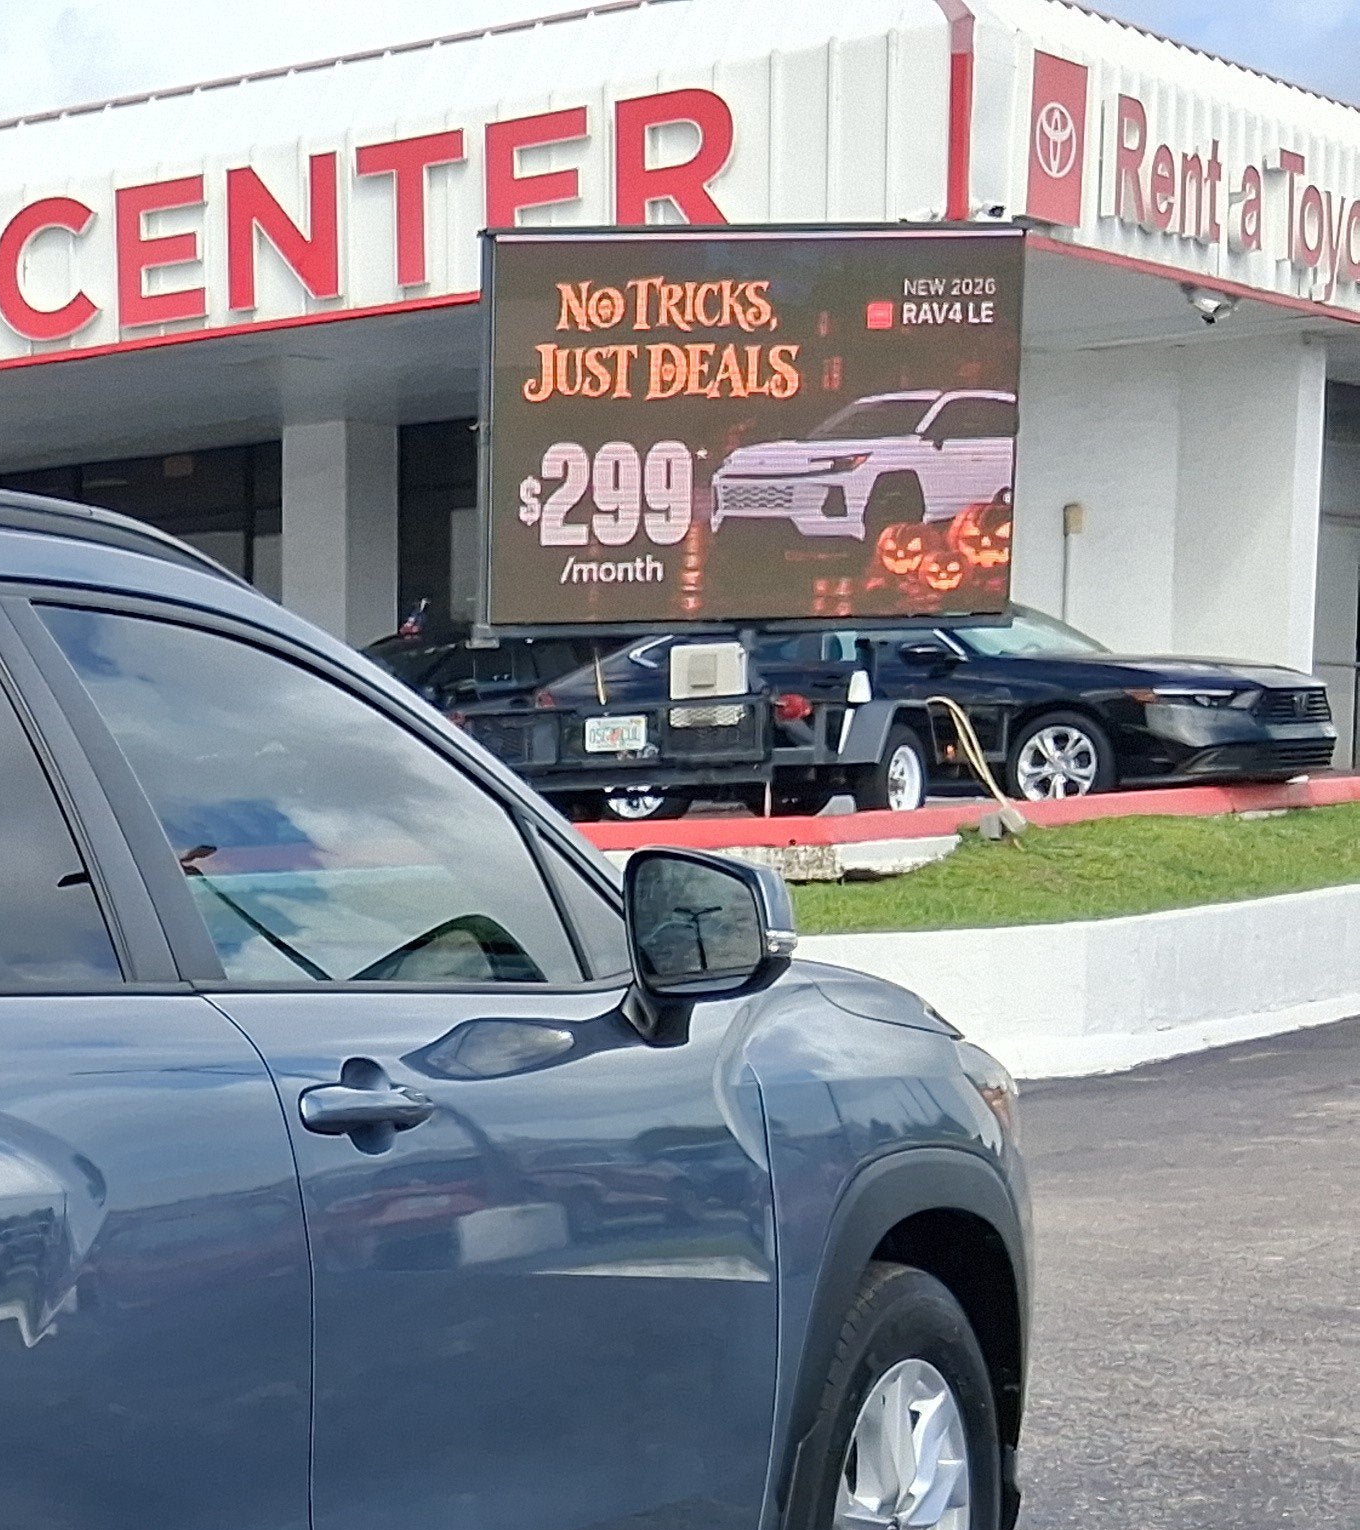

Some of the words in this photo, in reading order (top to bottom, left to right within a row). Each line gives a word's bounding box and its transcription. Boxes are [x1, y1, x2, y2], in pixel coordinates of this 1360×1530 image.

[1115, 92, 1222, 244] Rent
[903, 278, 946, 296] NEW
[951, 278, 997, 296] 2026
[902, 301, 963, 325] RAV4
[967, 301, 994, 324] LE
[523, 342, 638, 402] JUST
[644, 342, 800, 401] DEALS
[560, 554, 665, 584] /month
